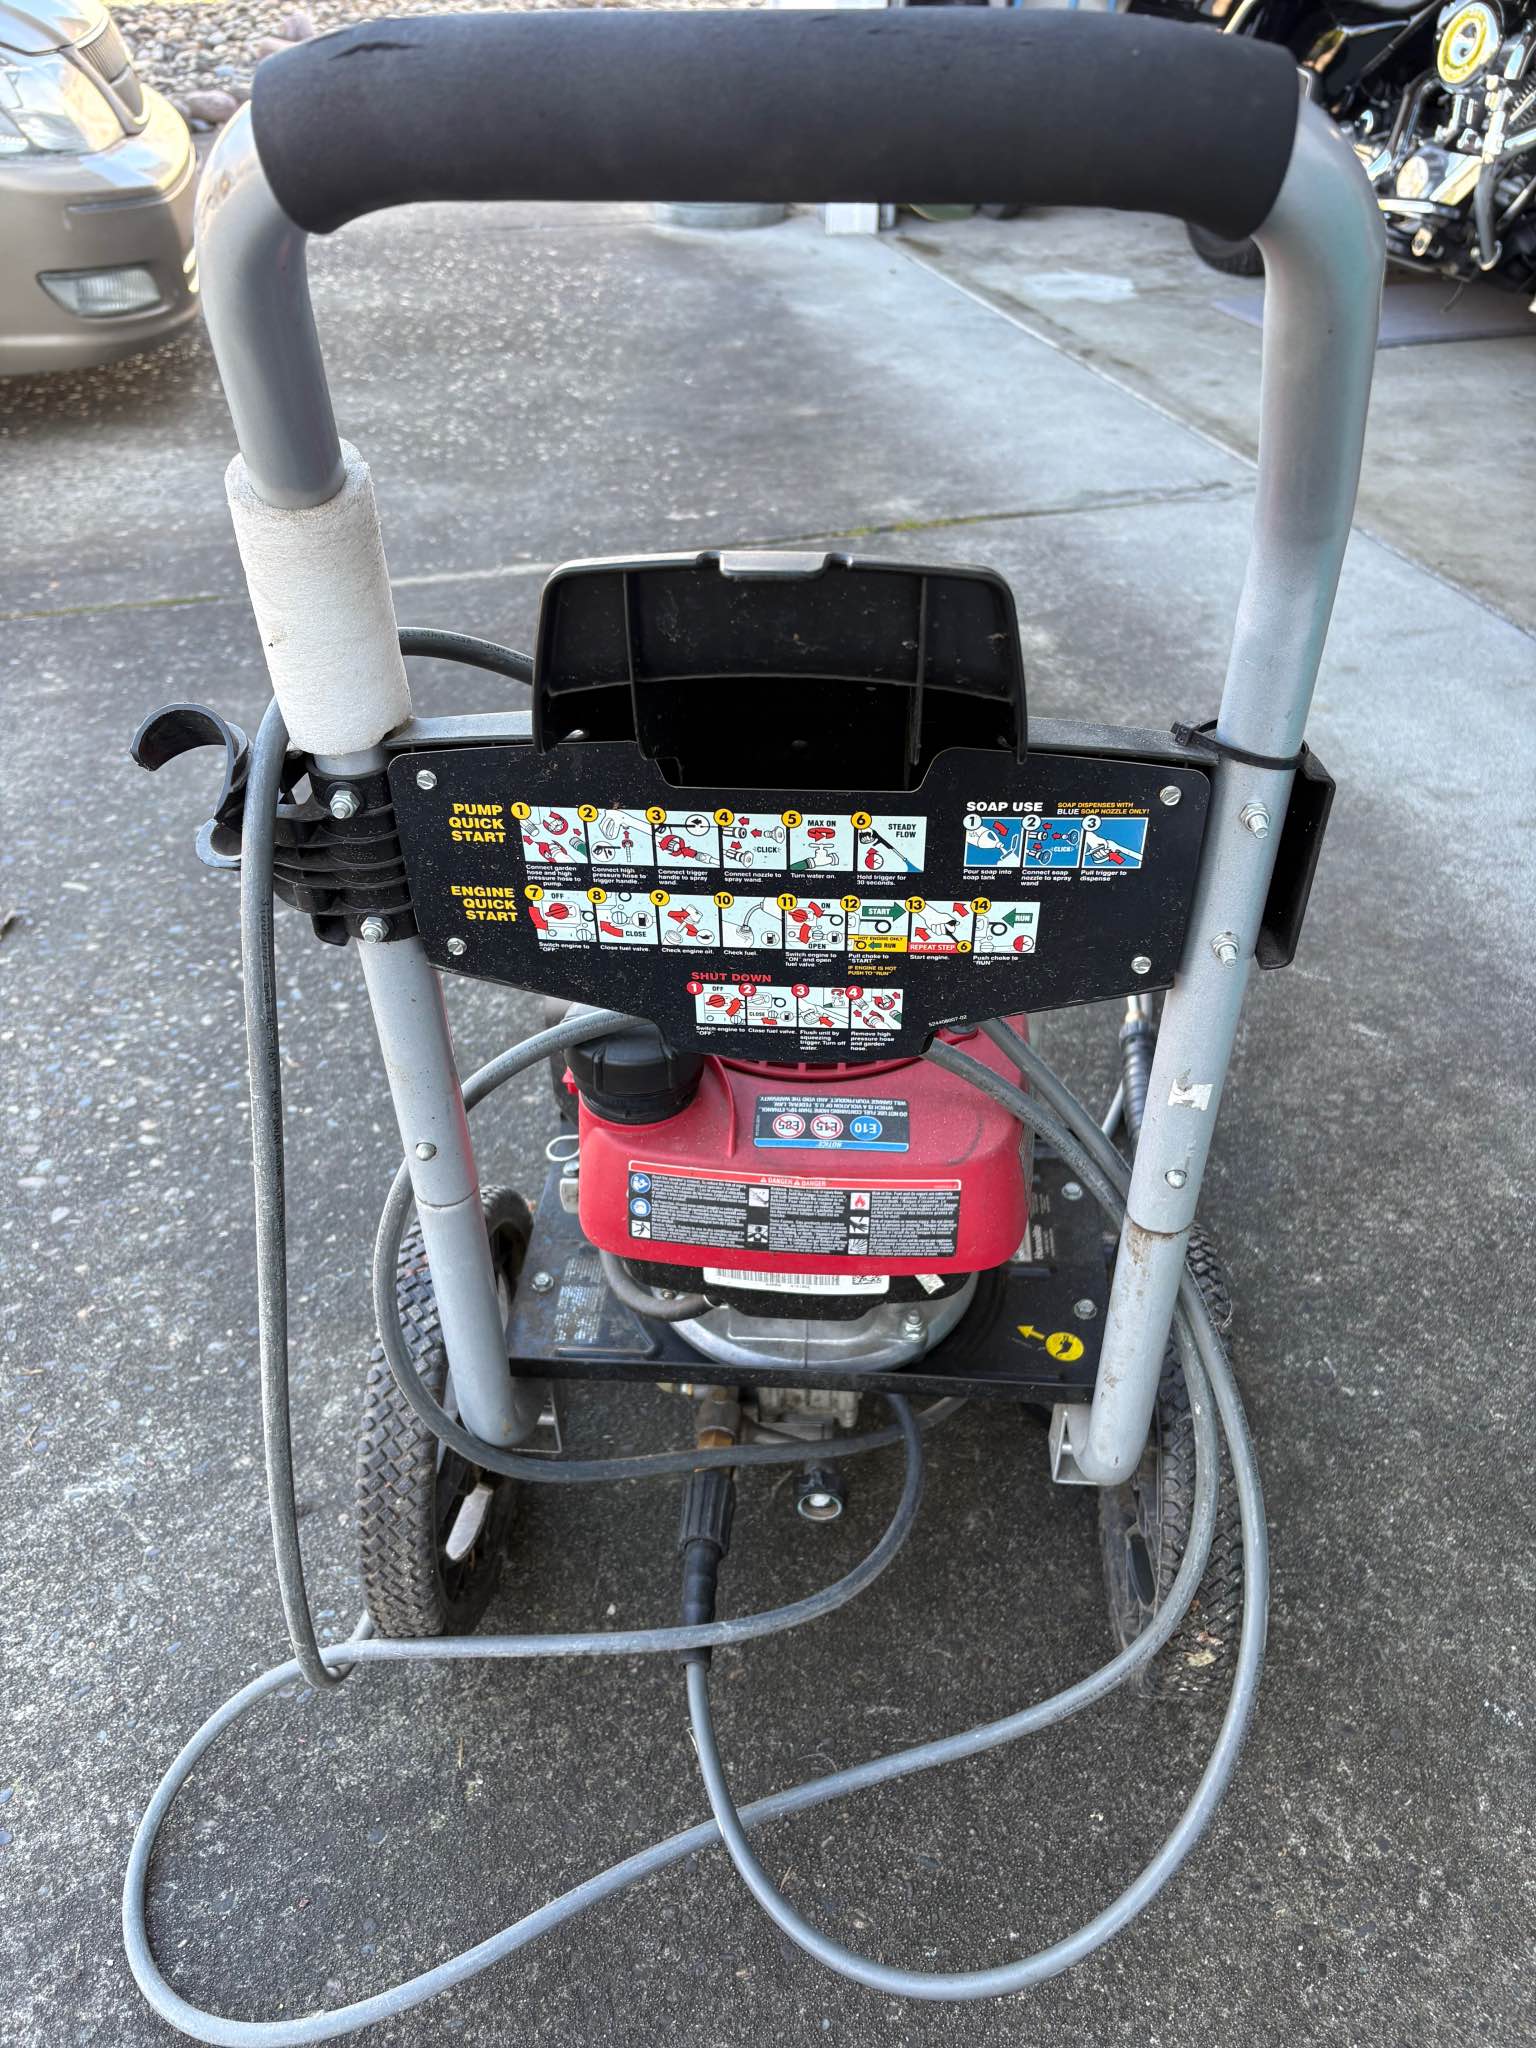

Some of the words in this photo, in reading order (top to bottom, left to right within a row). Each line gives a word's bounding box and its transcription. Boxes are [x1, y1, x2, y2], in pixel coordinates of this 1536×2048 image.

[453, 803, 502, 815] PUMP
[518, 805, 525, 816] 1
[584, 807, 592, 817] 2
[966, 802, 1008, 811] SOAP
[1013, 802, 1043, 812] USE
[652, 810, 661, 820] 3
[720, 812, 728, 822] 4
[788, 814, 796, 824] 5
[857, 815, 865, 825] 6
[449, 817, 504, 829] QUICK
[969, 817, 974, 826] 1
[1028, 818, 1035, 826] 2
[1088, 818, 1096, 827] 3
[452, 831, 505, 843] START
[451, 886, 515, 898] ENGINE
[530, 888, 538, 897] 7
[593, 891, 601, 900] 8
[656, 893, 663, 901] 9
[463, 899, 516, 909] QUICK
[717, 896, 730, 904] 10
[782, 897, 793, 906] 11
[844, 899, 857, 908] 12
[908, 900, 922, 910] 13
[974, 901, 988, 909] 14
[466, 910, 518, 921] START
[691, 972, 727, 980] SHUT
[732, 974, 771, 982] DOWN
[691, 984, 697, 992] 1
[778, 1121, 799, 1130] E85
[816, 1121, 837, 1130] E15
[855, 1124, 877, 1133] E10
